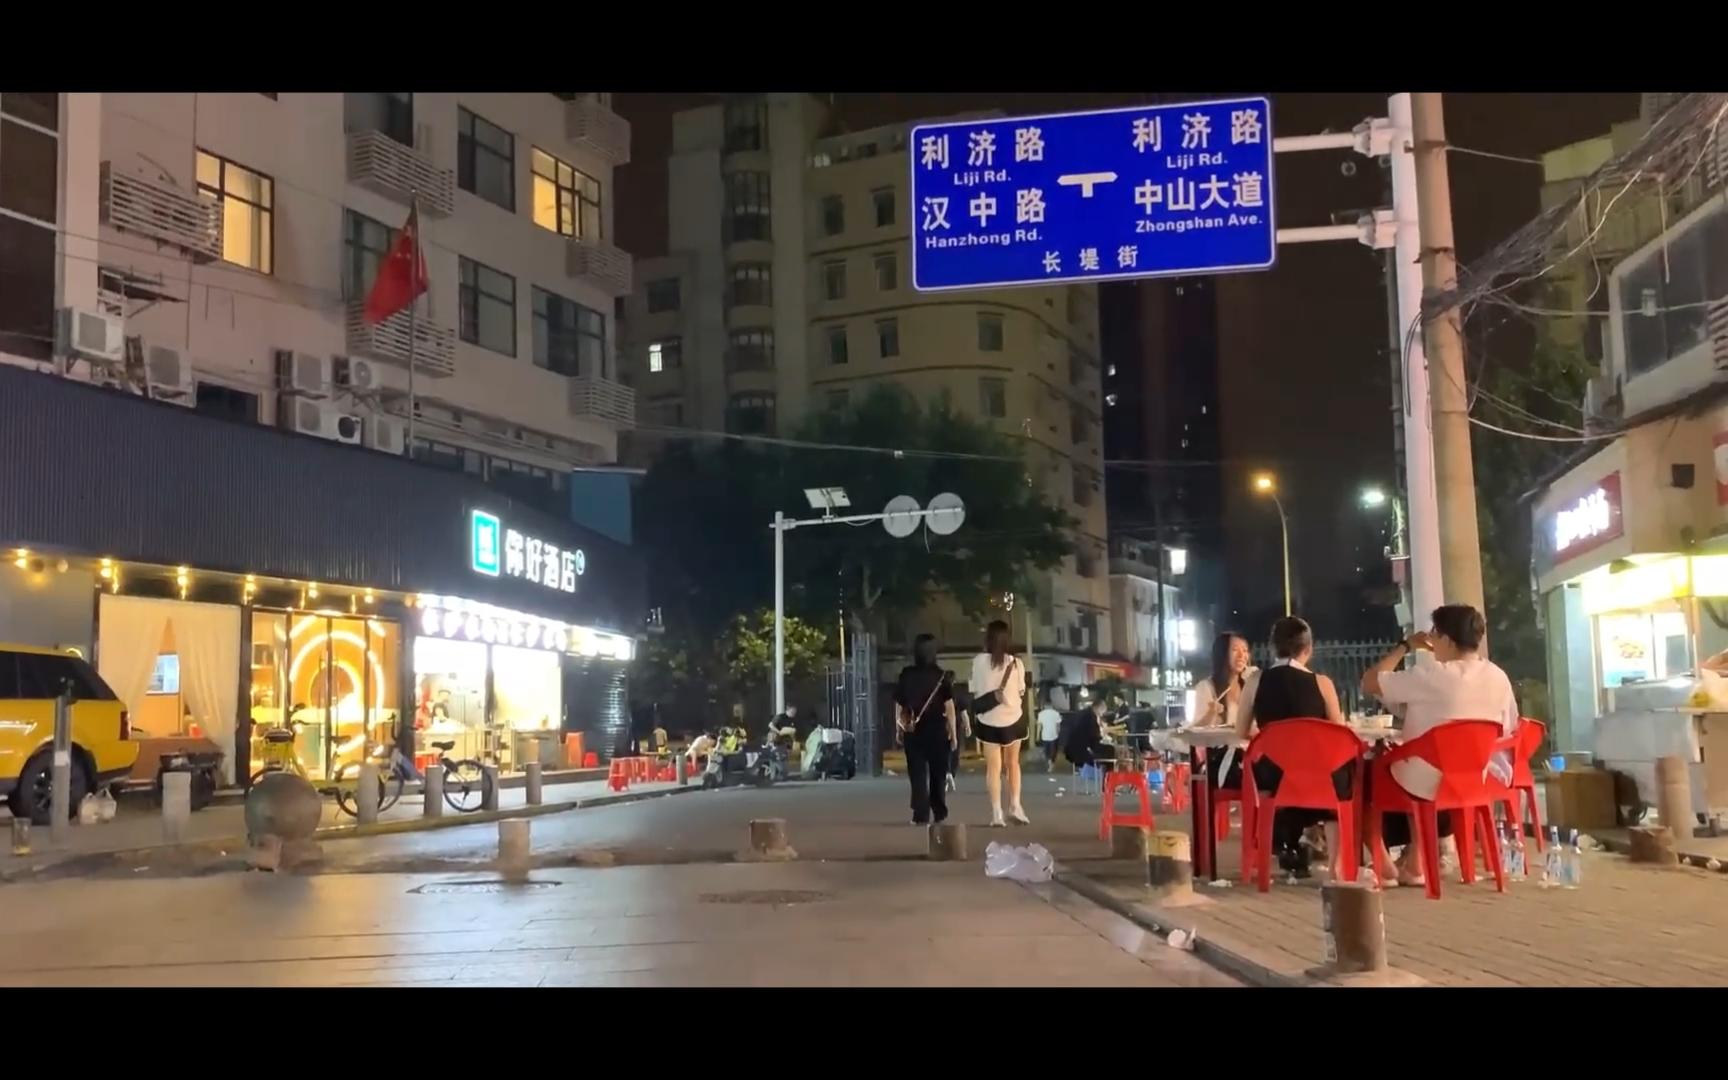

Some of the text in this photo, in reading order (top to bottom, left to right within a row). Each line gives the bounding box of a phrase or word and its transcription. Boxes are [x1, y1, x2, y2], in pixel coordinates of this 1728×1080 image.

[1132, 108, 1263, 153] 利济路
[921, 126, 1045, 170] 利济路
[1166, 152, 1228, 170] Liji Rd.
[953, 169, 1012, 187] Liji Rd.
[1134, 171, 1264, 215] 中山大道
[921, 188, 1046, 231] 汉中路
[1135, 213, 1264, 233] Zhongshan Ave.
[925, 228, 1043, 249] Hanzhong Rd.
[1042, 245, 1138, 273] 长堤街
